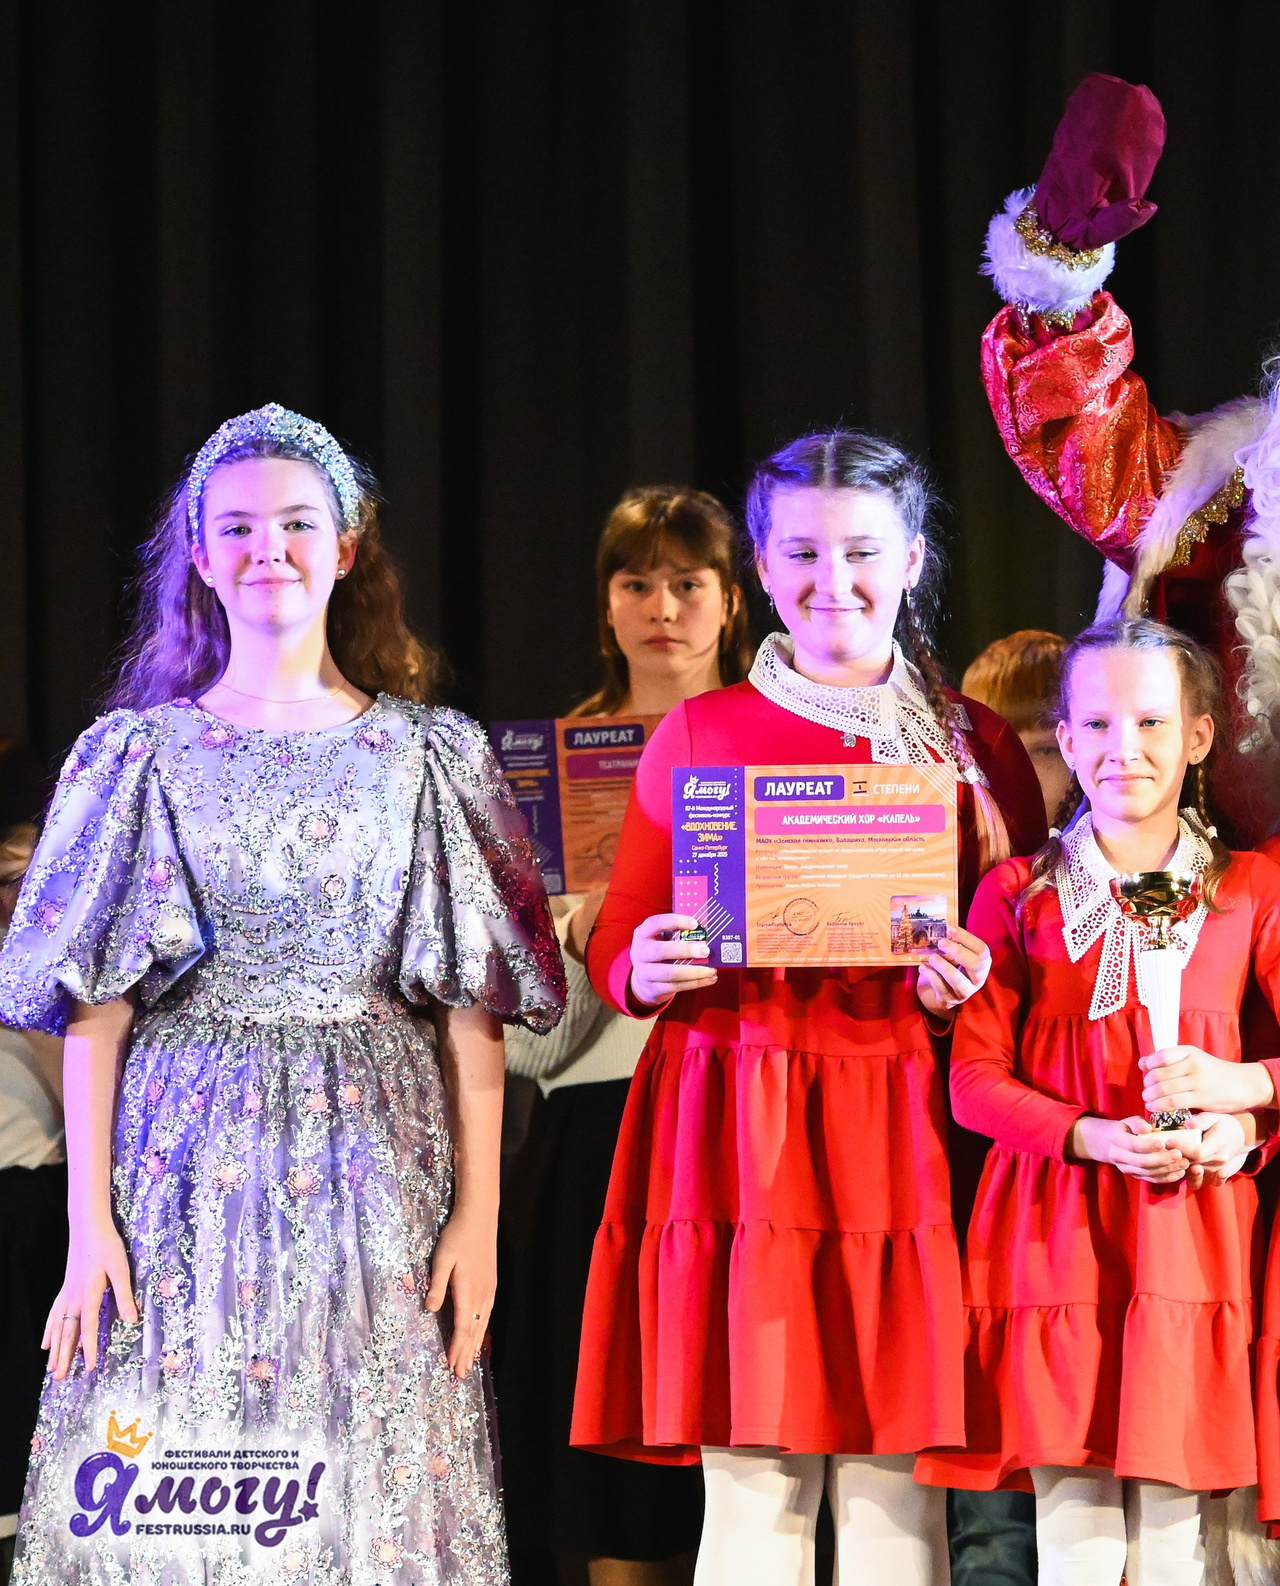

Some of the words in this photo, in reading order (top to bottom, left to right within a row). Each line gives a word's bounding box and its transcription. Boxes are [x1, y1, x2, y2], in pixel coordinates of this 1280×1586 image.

[573, 729, 635, 746] ЛАУРЕАТ
[764, 781, 834, 797] ЛАУРЕАТ
[873, 784, 920, 795] СТЕПЕНИ
[782, 813, 857, 825] АКАДЕМИЧЕСКИЙ
[858, 814, 875, 824] ХОР
[877, 813, 921, 824] «КАПЕЛЬ»
